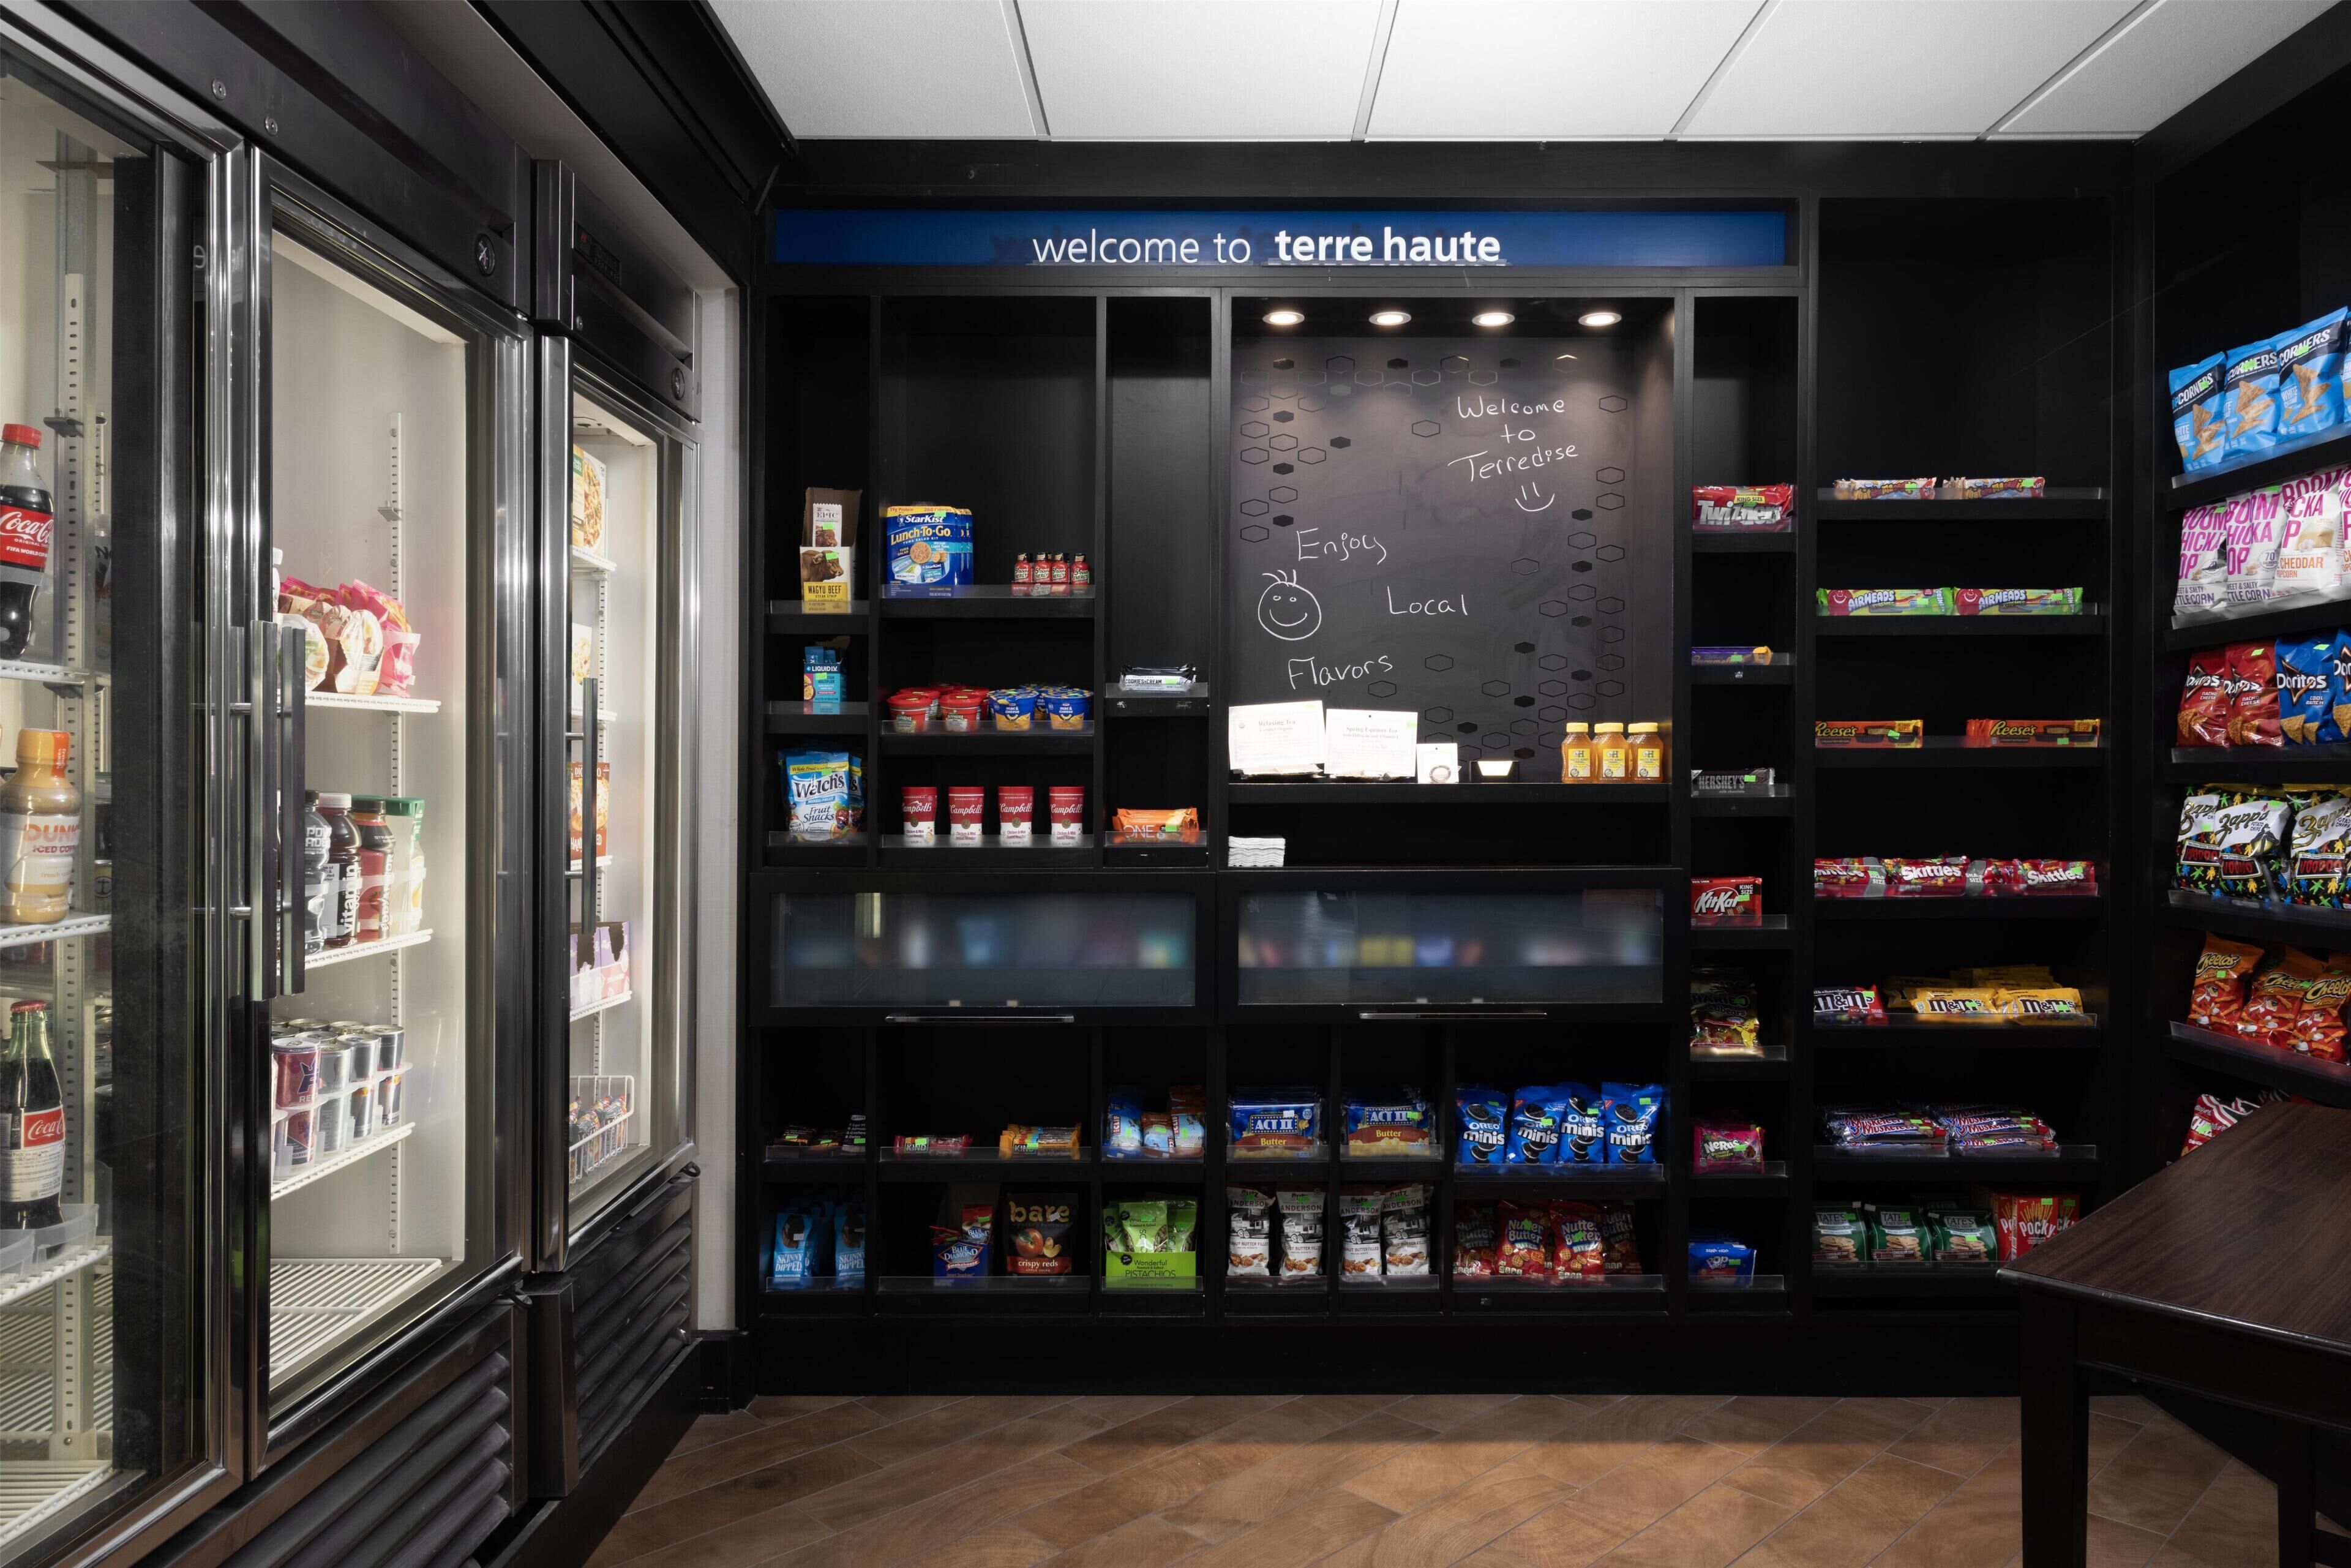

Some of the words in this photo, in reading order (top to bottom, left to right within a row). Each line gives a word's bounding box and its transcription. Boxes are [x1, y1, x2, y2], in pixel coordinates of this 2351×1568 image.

[1033, 229, 1199, 263] welcome
[1214, 233, 1251, 263] to
[1275, 230, 1373, 262] terre
[1384, 227, 1501, 262] haute
[1458, 397, 1565, 418] Welcome
[1501, 424, 1535, 444] to
[1448, 444, 1578, 482] Terredise
[15, 538, 40, 547] ORIGINAL
[1297, 528, 1386, 565] Enjoy
[2181, 531, 2223, 552] HICKA
[2280, 556, 2323, 569] CHEDDAR
[808, 585, 826, 594] WAGYU
[828, 585, 842, 594] BEEF
[2248, 588, 2270, 601] CORN
[1387, 586, 1468, 615] Local
[1848, 590, 1895, 611] AIRHEADS
[1978, 590, 2025, 611] AIRHEADS
[2191, 593, 2214, 605] CORN
[1288, 655, 1393, 689] Flavors
[2277, 673, 2327, 689] Doritos
[1815, 721, 1858, 737] Reese's
[1990, 721, 2037, 736] Reese's
[795, 773, 845, 798] Welch's
[1699, 775, 1745, 790] HERSHEY'S
[809, 805, 830, 816] Fruit
[950, 804, 982, 816] Campbell's
[1000, 803, 1032, 814] Campbell's
[1050, 803, 1082, 815] Campbell's
[803, 812, 834, 824] Snacks
[1123, 825, 1155, 838] ONE
[1901, 865, 1962, 880] Skittles
[2027, 869, 2084, 885] Skittles
[2196, 953, 2239, 977] Cheetos
[1370, 1111, 1393, 1122] ACT
[1395, 1111, 1408, 1121] II
[1567, 1114, 1598, 1123] OREO
[28, 1118, 64, 1141] Coca-C
[1255, 1120, 1278, 1131] ACT
[1280, 1119, 1293, 1130] II
[1469, 1122, 1499, 1130] OREO
[1562, 1122, 1605, 1138] minis
[1616, 1124, 1648, 1133] OREO
[1376, 1129, 1401, 1138] Butter
[1463, 1131, 1504, 1144] minis
[1518, 1127, 1558, 1144] minis
[1610, 1133, 1652, 1146] minis
[906, 1143, 926, 1152] KIND
[1383, 1199, 1421, 1210] ANDERSON
[1010, 1201, 1070, 1223] bare
[1509, 1231, 1542, 1244] Butter
[944, 1248, 978, 1261] DIAMOND
[951, 1245, 969, 1254] BLUE
[777, 1253, 803, 1264] SKINNY
[947, 1260, 978, 1269] Smokehouse
[1018, 1260, 1041, 1269] crispy
[775, 1261, 803, 1272] DIPPED
